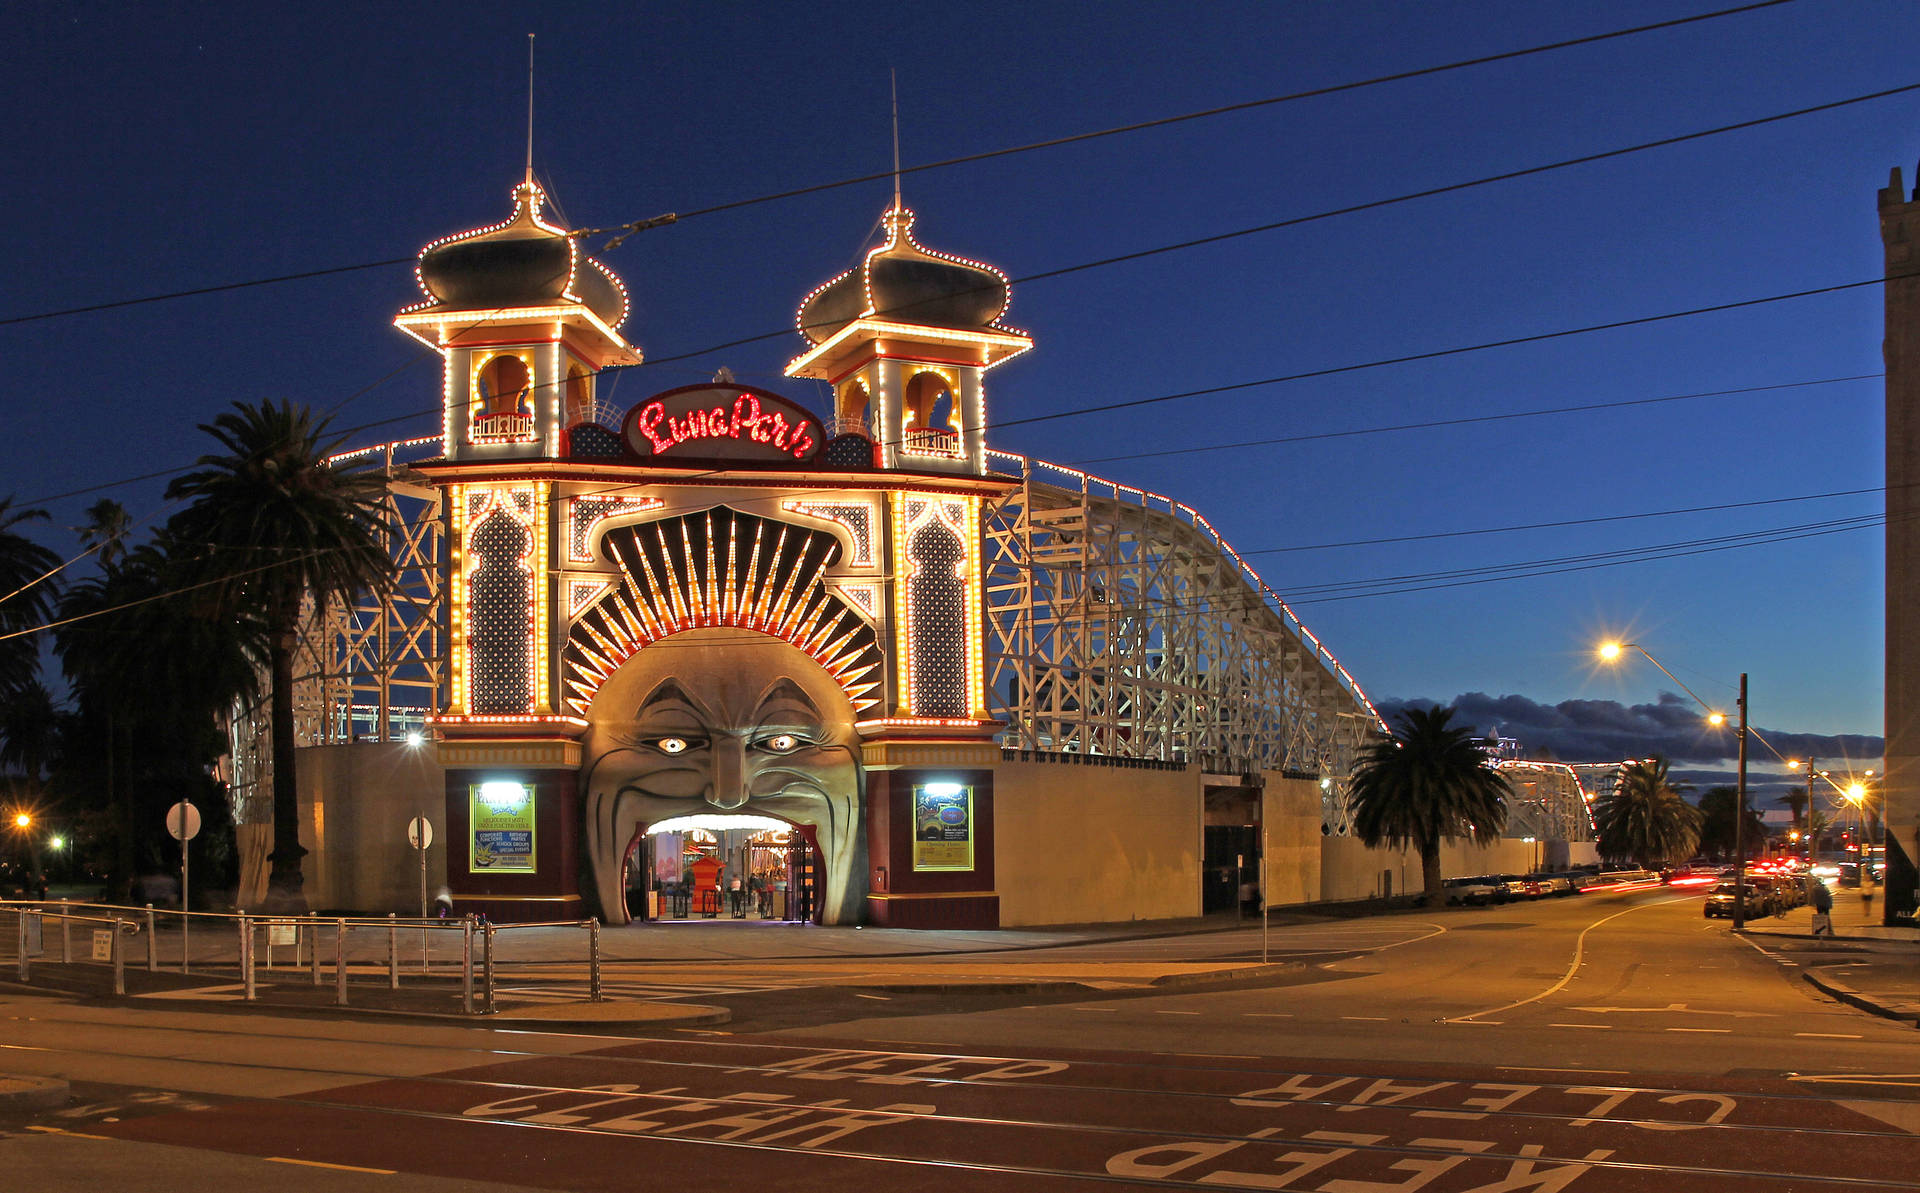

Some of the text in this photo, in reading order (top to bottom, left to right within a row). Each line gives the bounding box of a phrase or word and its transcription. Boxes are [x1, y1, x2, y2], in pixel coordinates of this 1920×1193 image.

[639, 393, 813, 458] Luna Park
[723, 1051, 1071, 1088] KEEP
[1229, 1073, 1737, 1131] CLEAR
[463, 1083, 938, 1148] CLEAR
[1105, 1127, 1617, 1193] KEEP
